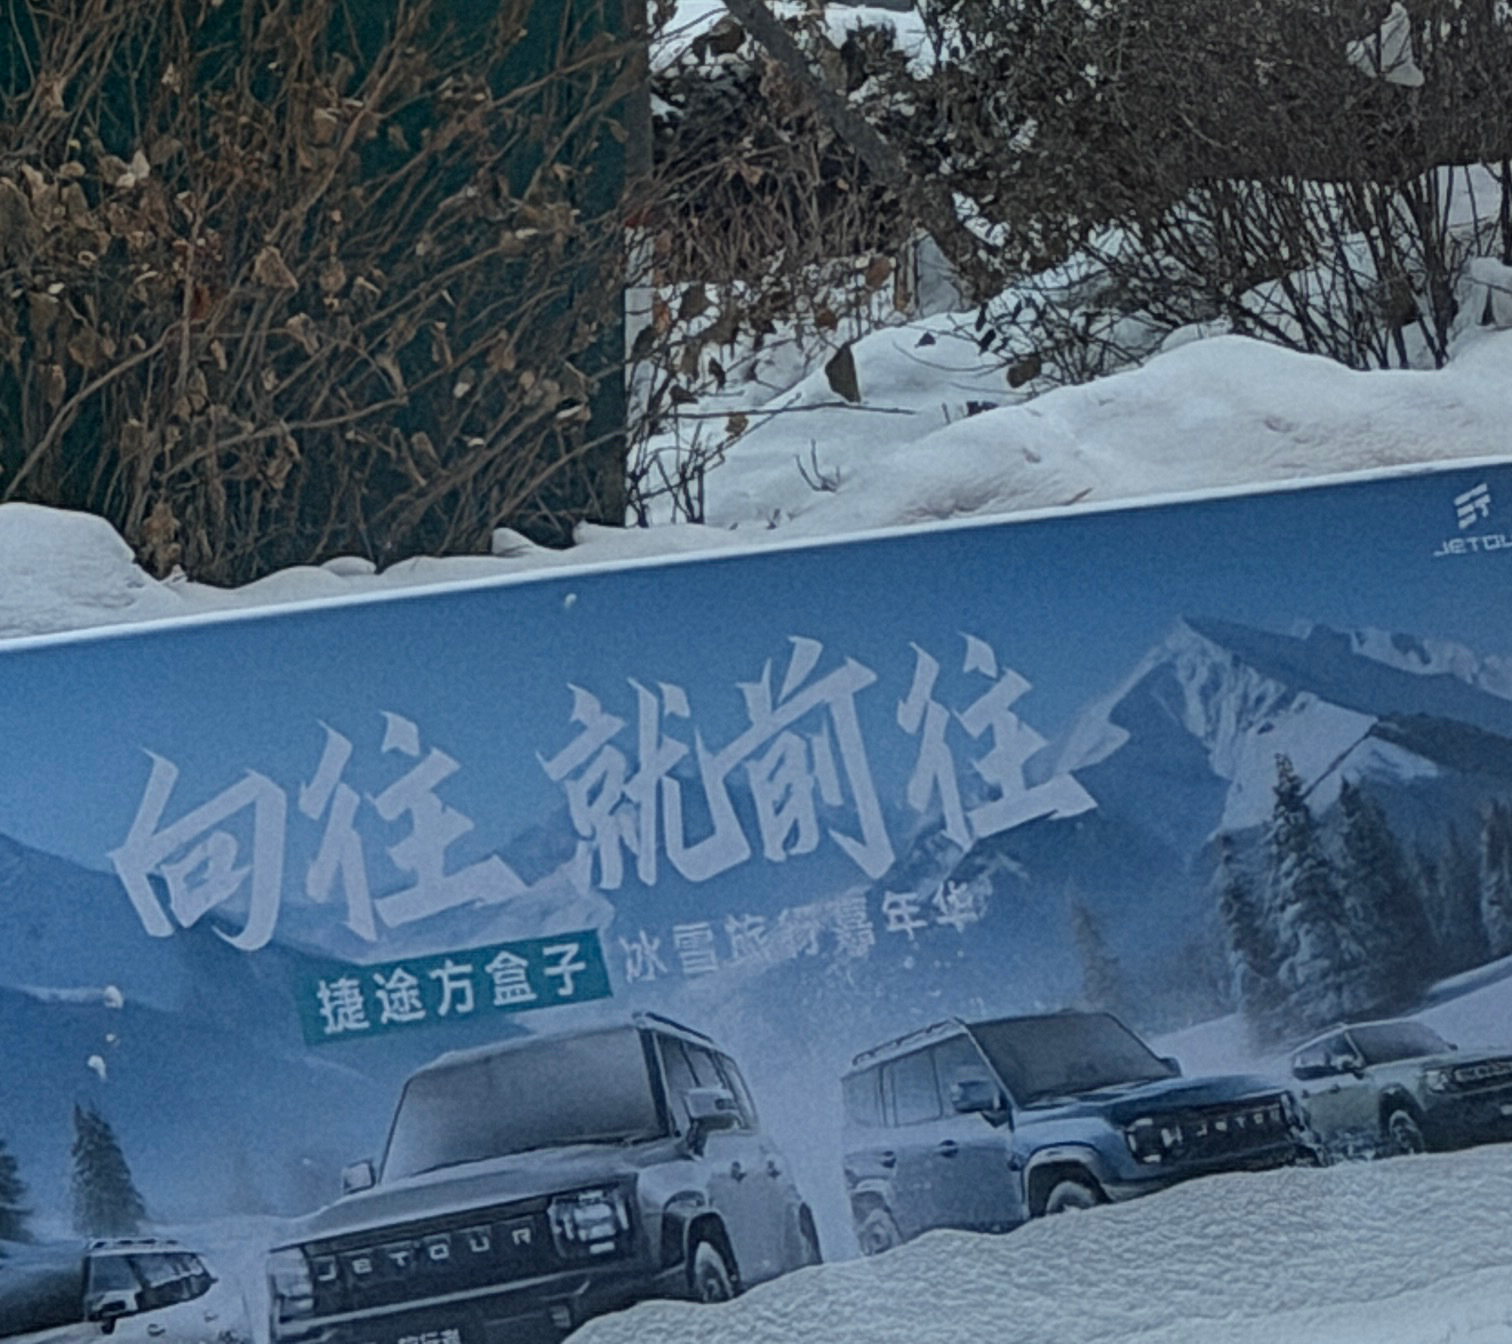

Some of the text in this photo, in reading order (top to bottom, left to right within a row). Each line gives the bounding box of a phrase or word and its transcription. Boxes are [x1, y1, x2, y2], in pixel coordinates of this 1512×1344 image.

[107, 631, 1099, 952] 向往 就前往
[316, 942, 587, 1035] 捷途方盒子
